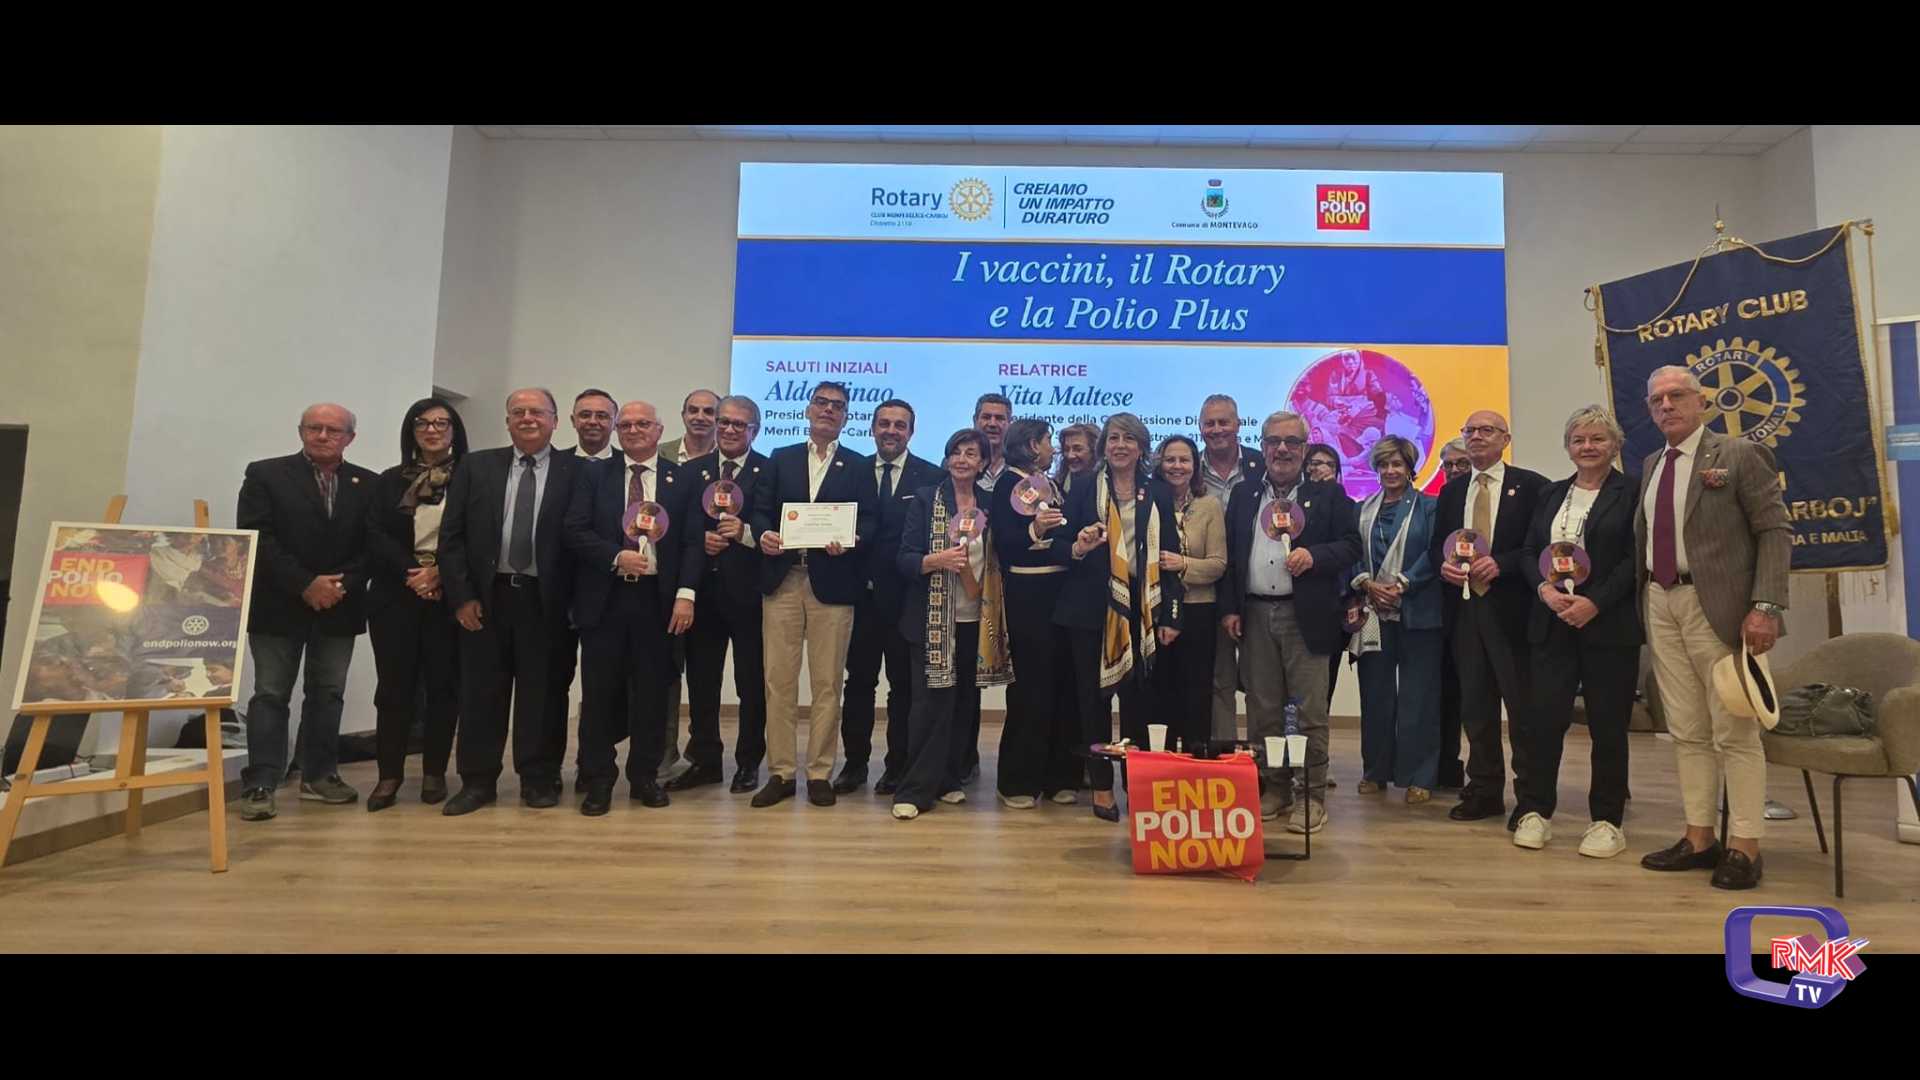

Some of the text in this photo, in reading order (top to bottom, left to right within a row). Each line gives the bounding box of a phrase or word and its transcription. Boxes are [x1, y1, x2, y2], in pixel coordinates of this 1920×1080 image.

[1013, 182, 1088, 195] CREIAMO
[871, 187, 943, 210] Rotary
[1327, 190, 1359, 202] END
[1018, 197, 1115, 210] UN IMPATTO
[1319, 200, 1366, 214] POLIO
[1021, 211, 1110, 224] DURATURO
[1324, 211, 1361, 224] NOW
[1210, 221, 1258, 229] MONTEVAGO
[952, 251, 1285, 294] I vaccini, il Rotary
[989, 296, 1249, 331] e la Polio Plus
[1638, 289, 1808, 343] ROTARY CLUB
[766, 361, 888, 374] SALUTI INIZIALI
[1696, 350, 1751, 372] ROTARY
[999, 363, 1088, 377] RELATRICE
[849, 380, 894, 402] inao
[1000, 384, 1133, 407] Vita Maltese
[765, 409, 806, 420] Presid
[1068, 414, 1096, 424] della
[1101, 414, 1182, 425] Cissione
[764, 425, 800, 437] Menfi
[1809, 533, 1819, 543] E
[1822, 530, 1868, 544] MALTA
[61, 557, 115, 573] END
[48, 571, 124, 585] POLIO
[143, 639, 237, 649] endpolionow.org
[1152, 778, 1236, 811] END
[1135, 808, 1255, 842] POLIO
[1151, 839, 1246, 870] NOW
